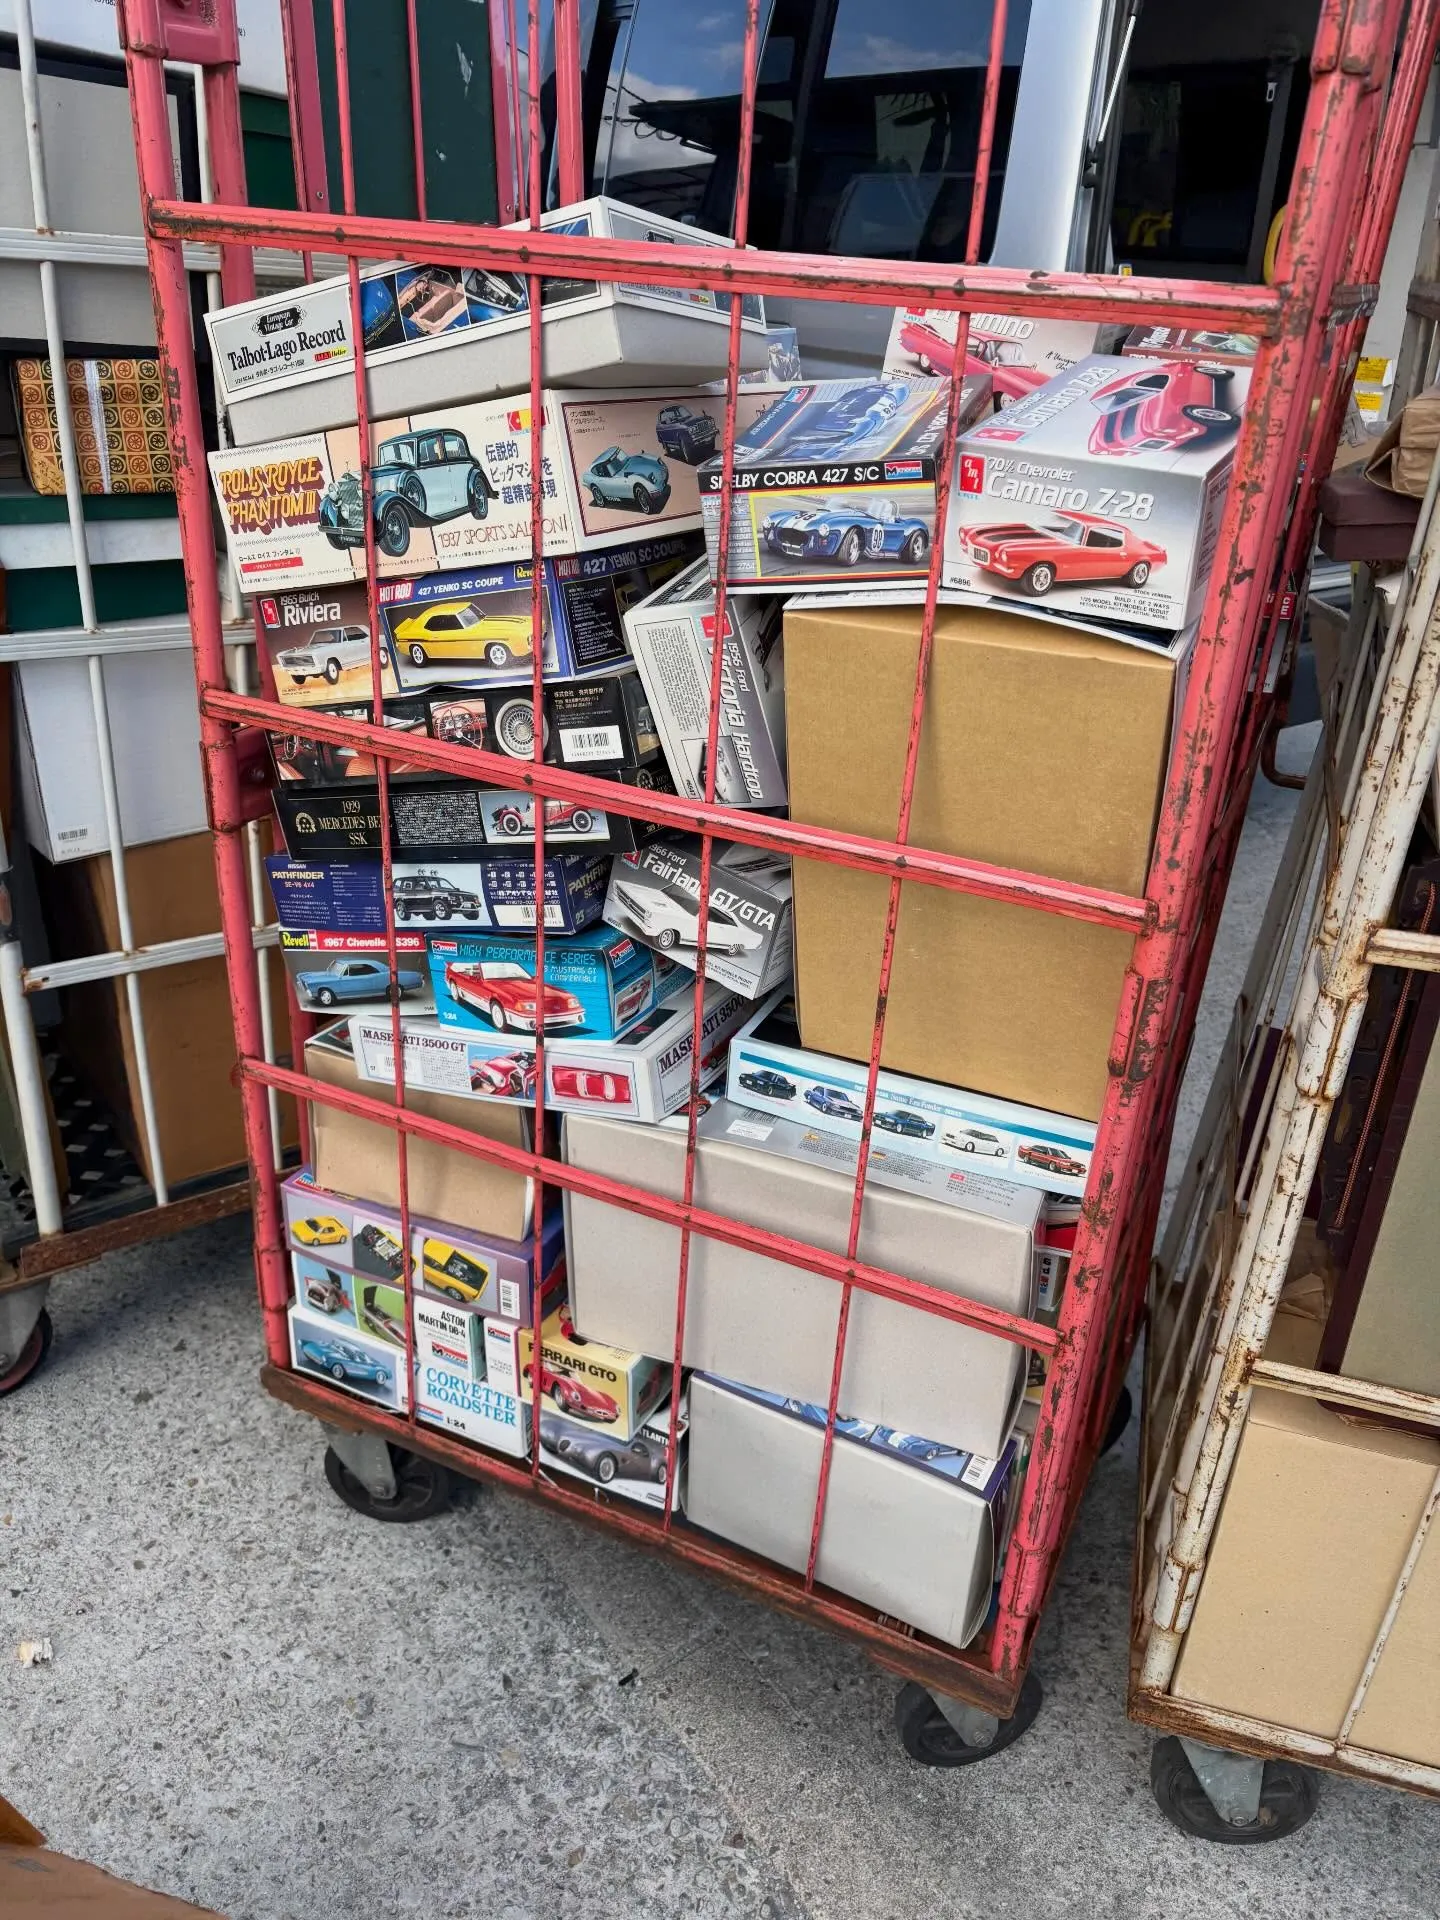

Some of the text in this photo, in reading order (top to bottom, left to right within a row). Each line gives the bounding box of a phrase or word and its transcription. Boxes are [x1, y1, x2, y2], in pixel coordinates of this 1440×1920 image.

[228, 319, 346, 371] Talbot-Lago Record
[486, 440, 519, 463] 伝説的
[764, 468, 818, 488] COBRA
[822, 467, 848, 483] 427
[853, 465, 880, 481] S/C
[1017, 461, 1076, 483] Chevrolet
[986, 472, 1154, 522] Camaro Z-28
[226, 491, 305, 535] PHANTOM
[438, 531, 461, 549] 1937
[464, 525, 507, 546] SPORTS
[873, 529, 883, 549] 98
[583, 556, 607, 572] 427
[609, 551, 637, 569] YENKO
[638, 547, 653, 563] SC
[379, 583, 412, 602] HOT ROD
[418, 577, 504, 596] 427 YENKO SC COUPE
[950, 576, 972, 588] #6896
[281, 592, 320, 605] 1965 Buick
[284, 602, 341, 627] Riviera
[727, 641, 751, 693] 1956 Ford
[732, 731, 764, 801] Hardtop
[342, 800, 361, 814] 1929
[318, 816, 366, 830] MERCEDES
[349, 832, 368, 846] SSK
[649, 844, 687, 866] 966 Ford
[272, 871, 325, 880] PATHFINDER
[643, 853, 777, 932] Fairlan GT/GTA
[282, 931, 309, 946] Revell
[324, 938, 344, 948] 1967
[347, 937, 386, 948] Chevelle
[459, 943, 482, 956] HIGH
[561, 953, 596, 966] SERIES
[363, 1029, 420, 1048] MASEATI
[422, 1039, 449, 1051] 3500
[450, 1042, 467, 1053] GT
[659, 1014, 721, 1075] MASEATI
[419, 1313, 447, 1331] MARTIN
[441, 1311, 465, 1328] ASTON
[588, 1364, 617, 1383] GTO
[427, 1367, 516, 1412] CORVETTE
[427, 1382, 516, 1428] ROADSTER
